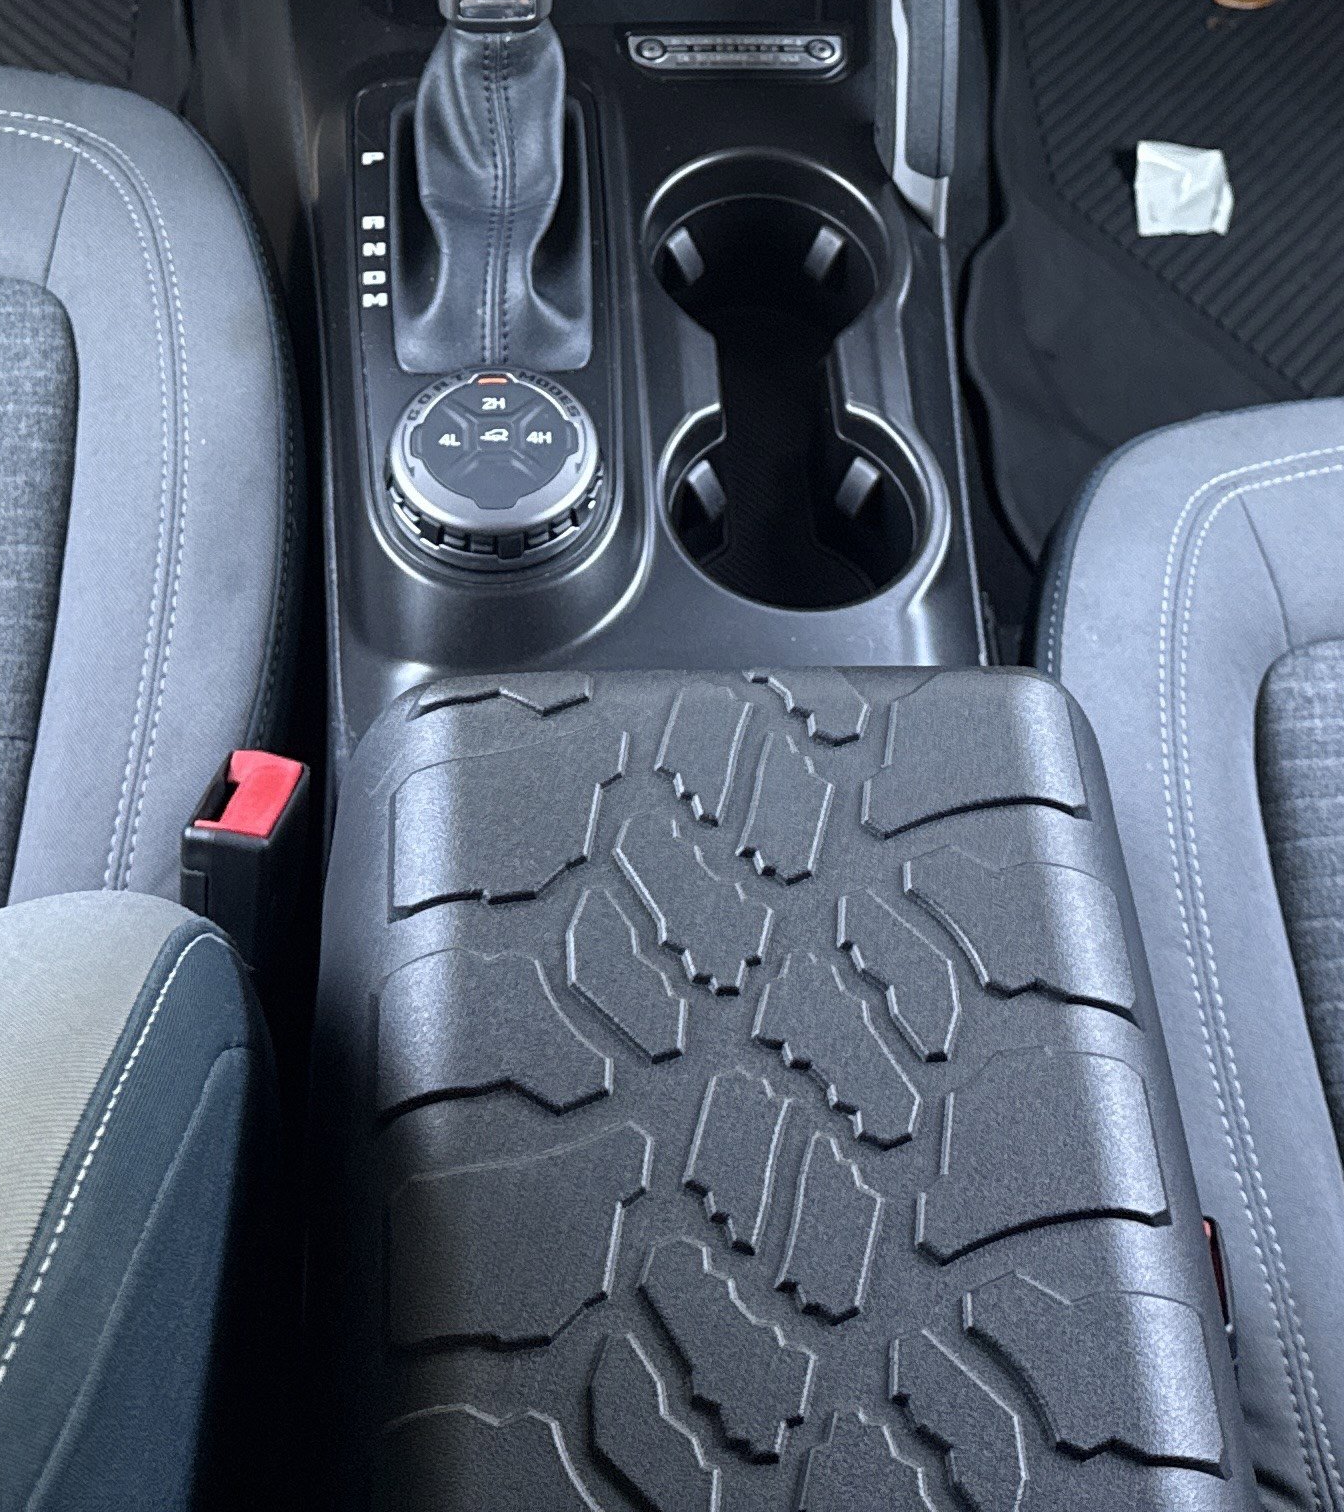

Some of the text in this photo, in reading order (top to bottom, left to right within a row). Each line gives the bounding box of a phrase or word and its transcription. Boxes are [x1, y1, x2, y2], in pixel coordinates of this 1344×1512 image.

[361, 151, 385, 166] P
[362, 242, 386, 257] N
[362, 293, 388, 308] M
[518, 371, 581, 418] MODES
[481, 397, 506, 410] 2H
[438, 431, 552, 447] 4L 4H
